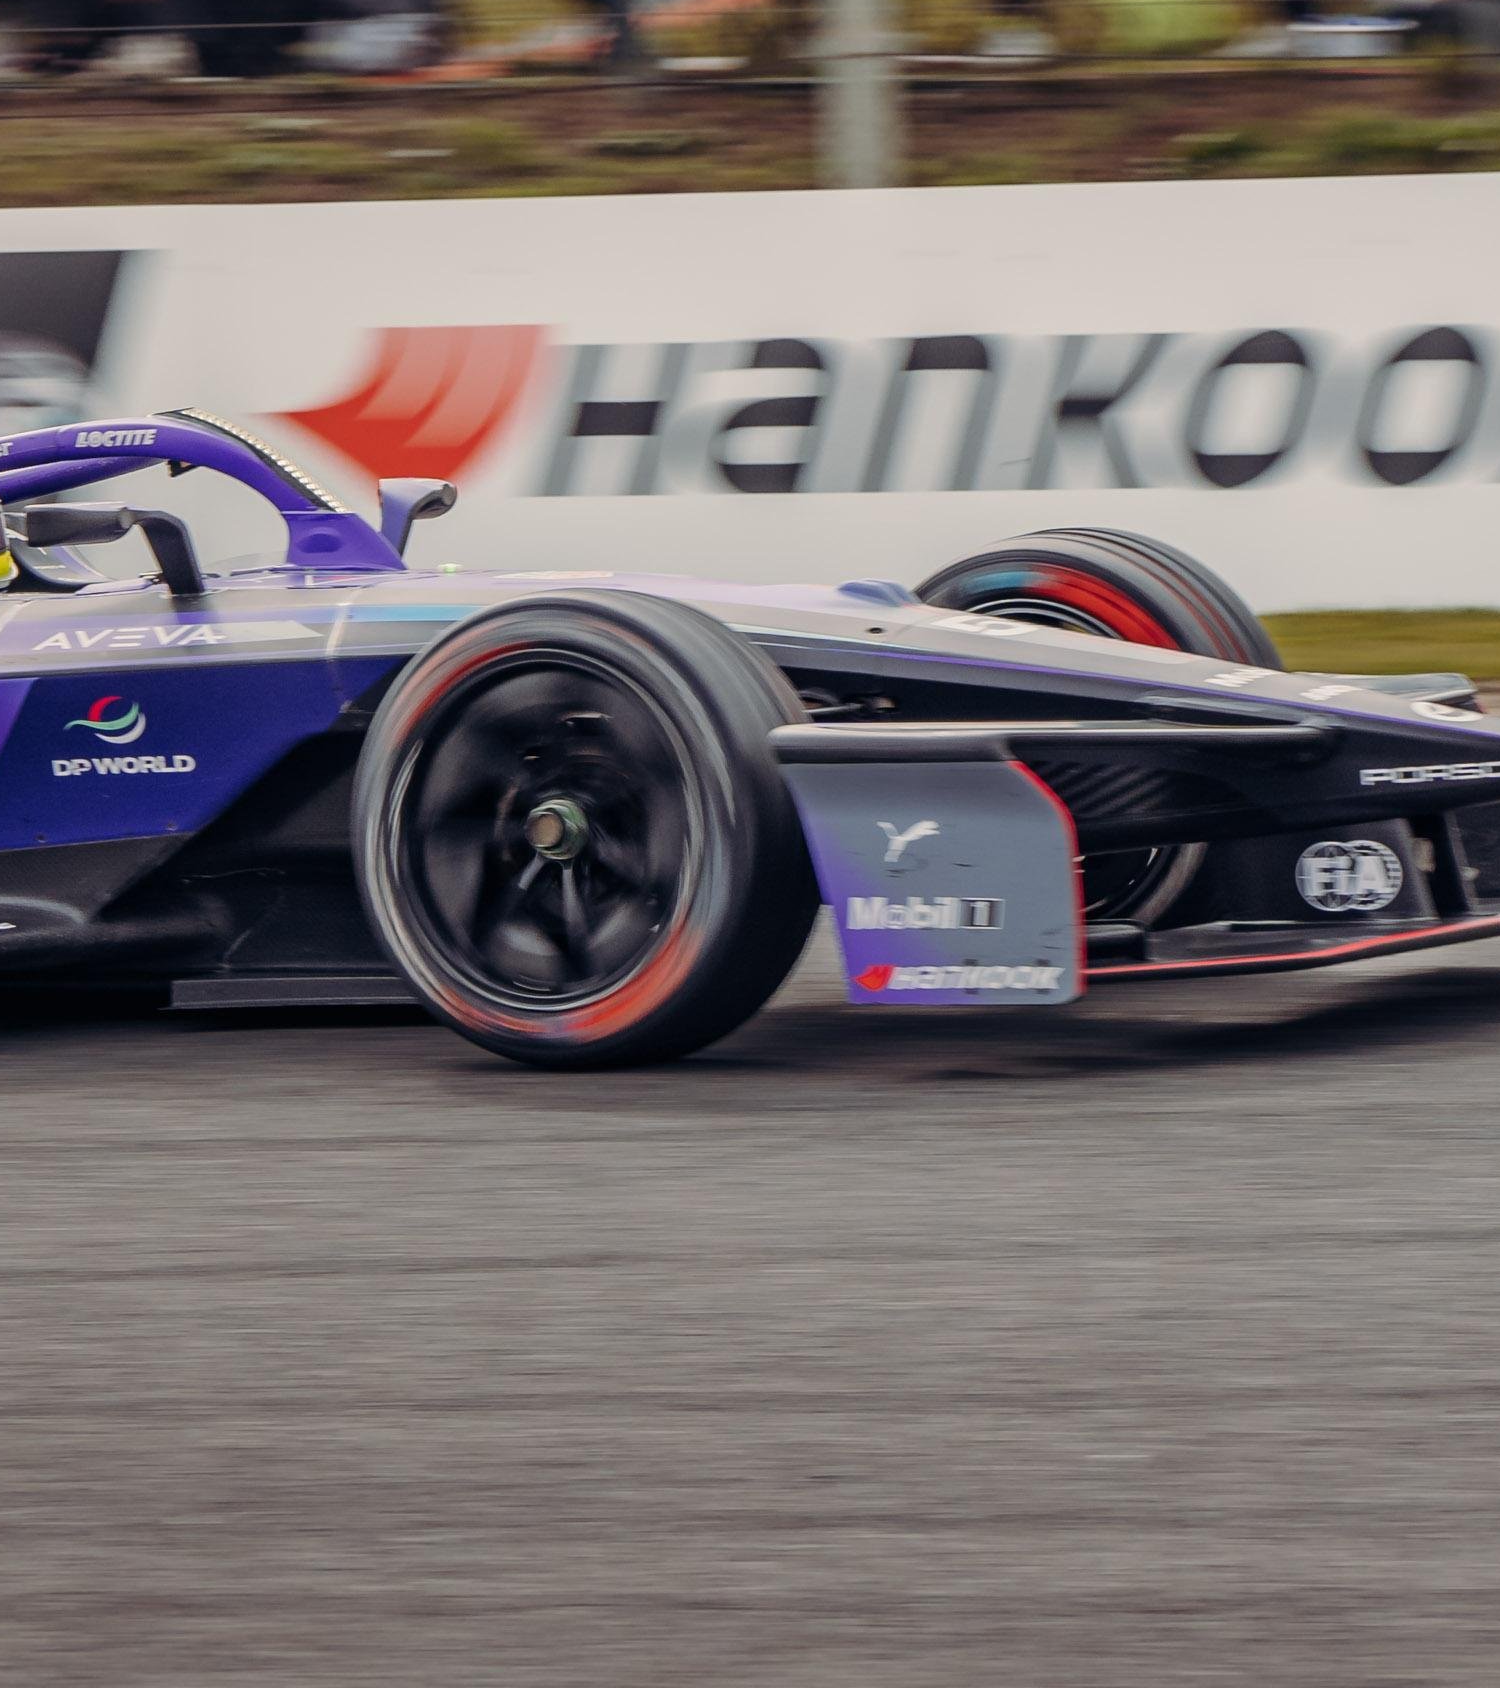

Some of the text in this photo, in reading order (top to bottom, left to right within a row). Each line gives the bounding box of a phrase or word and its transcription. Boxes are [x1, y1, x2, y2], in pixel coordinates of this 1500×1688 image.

[75, 429, 158, 448] LOCTITE
[31, 624, 228, 651] AVEVA
[51, 755, 197, 777] DP WORLD
[847, 897, 961, 930] Mobil
